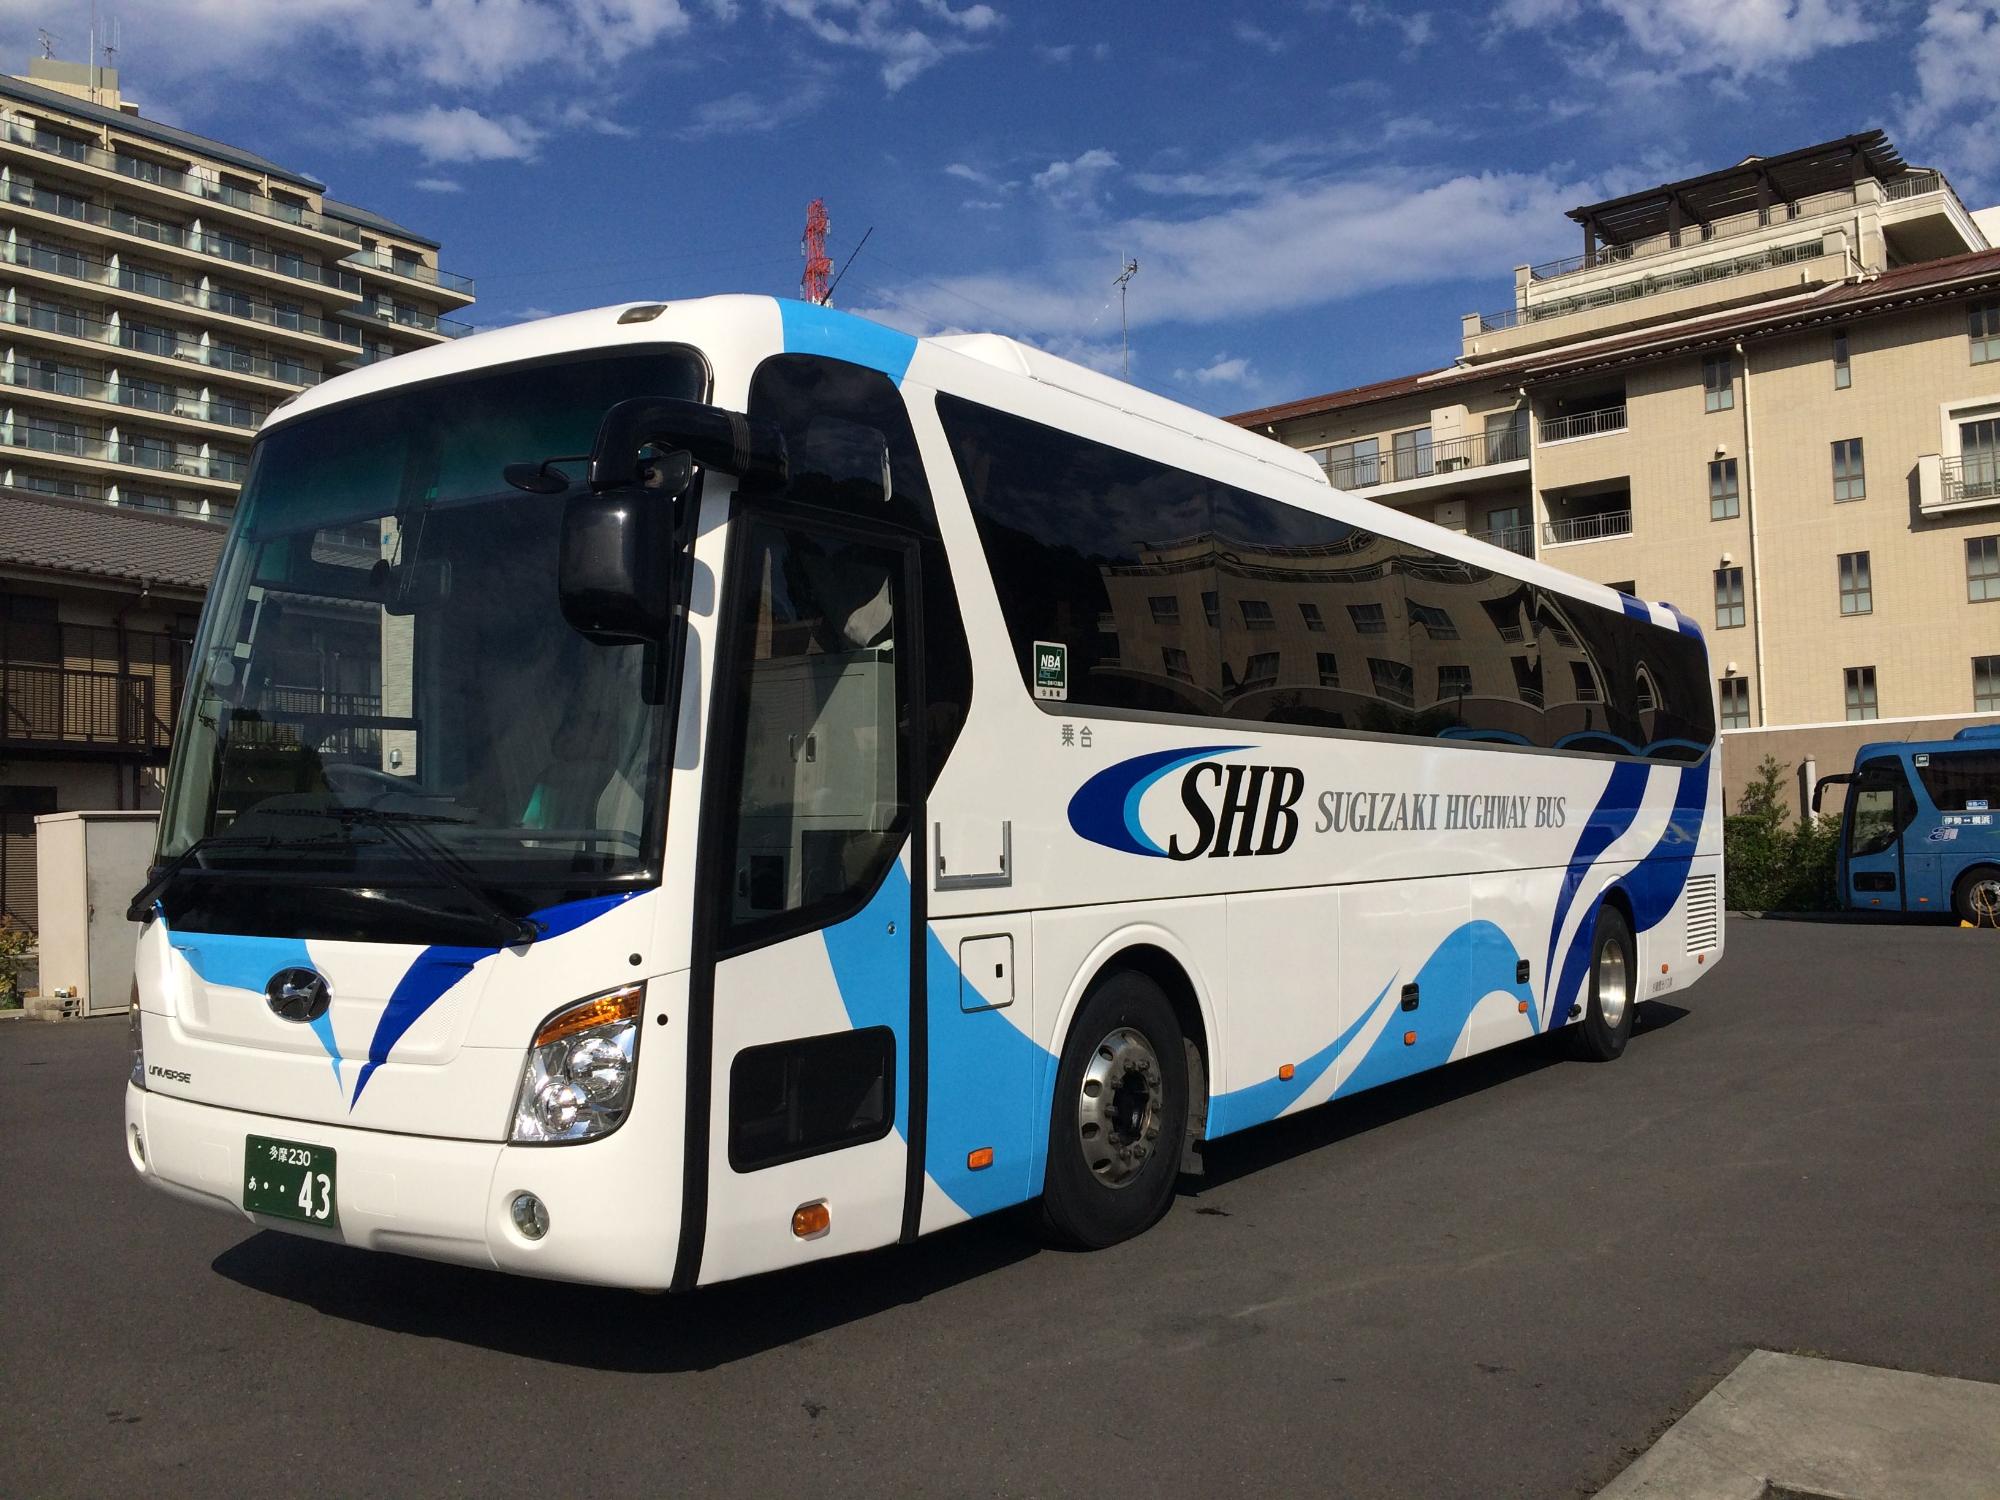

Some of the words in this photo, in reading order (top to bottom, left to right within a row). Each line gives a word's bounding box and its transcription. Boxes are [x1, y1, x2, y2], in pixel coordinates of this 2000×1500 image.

[1041, 655, 1061, 669] NBA
[1062, 724, 1093, 748] 乗合
[1168, 761, 1305, 862] SHB
[1315, 790, 1440, 834] SUGIZAKI
[1444, 793, 1532, 831] HIGHWAY
[1534, 796, 1567, 829] BUS
[148, 1064, 192, 1084] UNIVERSE
